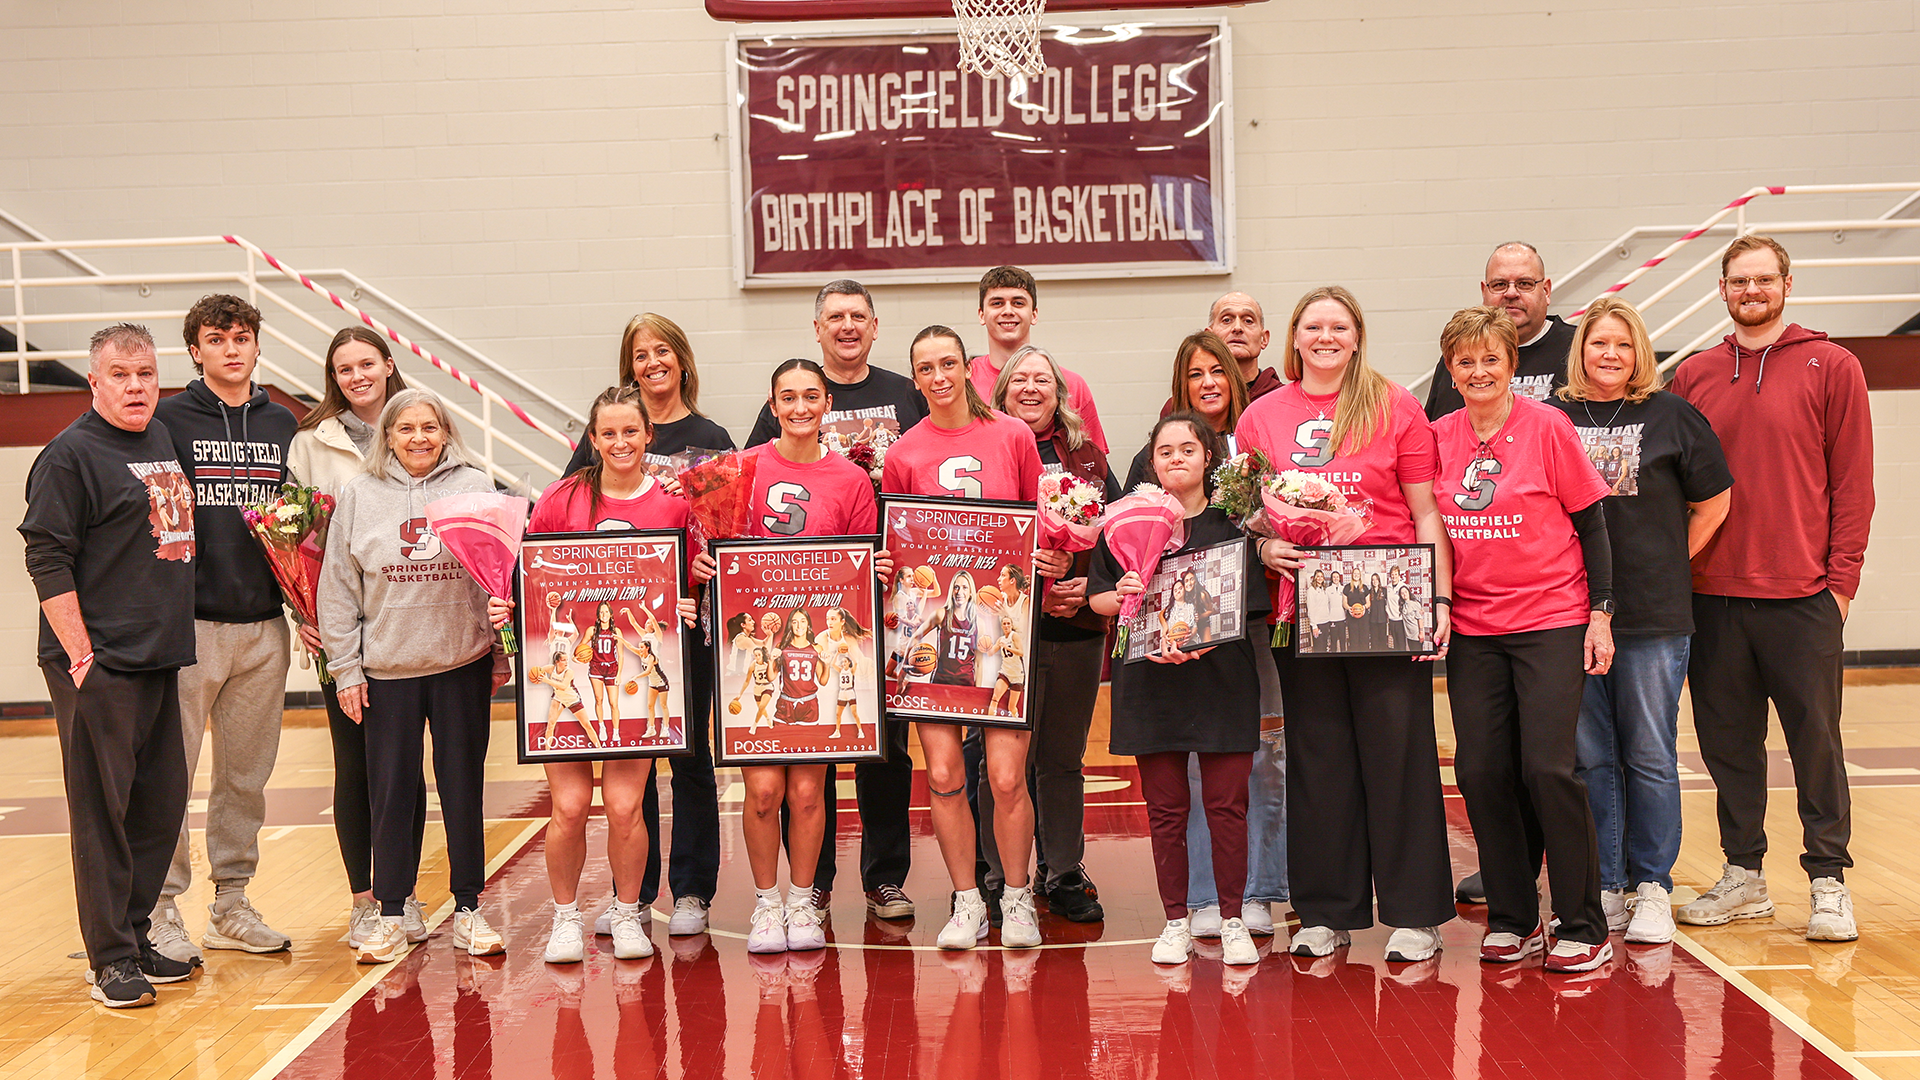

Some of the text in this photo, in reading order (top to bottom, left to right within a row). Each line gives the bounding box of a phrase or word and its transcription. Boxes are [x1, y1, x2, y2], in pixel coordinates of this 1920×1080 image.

[776, 63, 1182, 133] SPRINGFIELD COLLEGE
[761, 183, 1204, 252] BIRTHPLACE OF BASKETBALL
[1523, 373, 1555, 386] DAY
[821, 404, 896, 425] RIPLE THREAT
[1575, 423, 1645, 437] NIOR DAY
[192, 440, 281, 465] SPRINGFIELD
[915, 510, 1008, 528] SPRINGFIELD
[1440, 514, 1523, 526] PRINGFIELD
[927, 526, 994, 543] COLLEGE
[1447, 527, 1520, 539] SKETBALL
[552, 545, 648, 560] SPRINGFIELD
[901, 543, 1023, 556] WOMEN'S BASKETBALL
[748, 551, 843, 567] SPRINGFIELD
[973, 555, 999, 570] HESS
[381, 562, 464, 574] SPRINGFIEL
[566, 561, 635, 576] COLLEGE
[761, 567, 830, 583] COLLEGE
[387, 572, 463, 583] BASKETBALL
[539, 578, 666, 588] WOMEN'S BASKETBALL
[807, 592, 843, 608] PADULA
[597, 638, 612, 654] 10
[948, 634, 971, 660] 15
[789, 659, 812, 681] 33
[841, 675, 850, 684] 33
[886, 694, 929, 710] POSSE
[931, 704, 964, 713] CLASS
[972, 707, 984, 715] OF
[537, 735, 585, 749] POSSE
[587, 739, 622, 748] CLASS
[734, 740, 781, 754] POSSE
